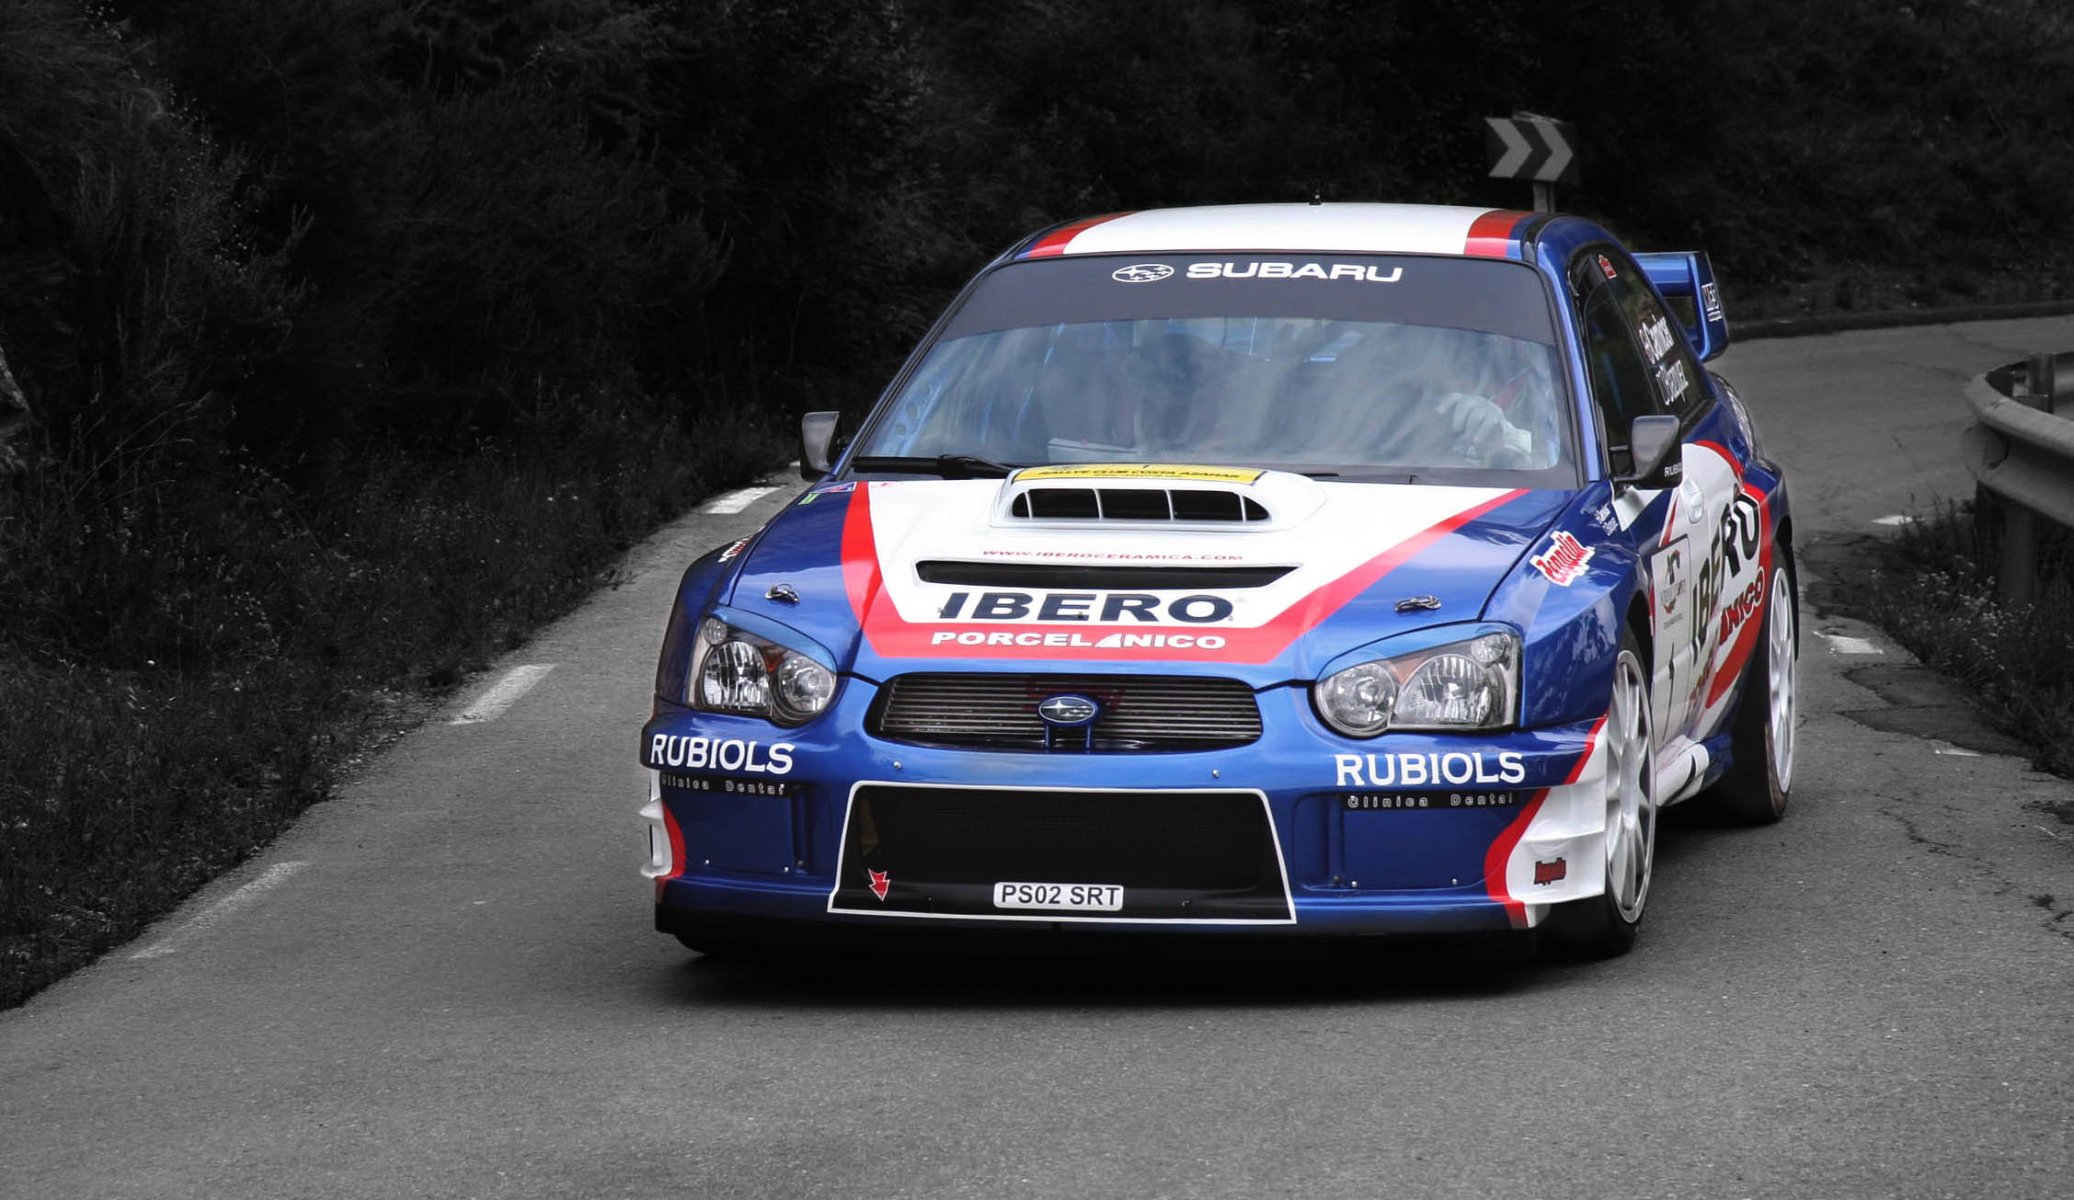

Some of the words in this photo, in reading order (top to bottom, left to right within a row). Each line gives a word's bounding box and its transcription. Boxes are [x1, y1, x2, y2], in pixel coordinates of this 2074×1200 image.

[1186, 262, 1403, 283] SUBARU
[1691, 490, 1761, 667] IBERO
[938, 592, 1235, 624] IBERO
[930, 631, 1227, 650] PORCELANICO
[650, 733, 796, 775] RUBIOLS
[1334, 752, 1526, 786] RUBIOLS
[1450, 792, 1513, 807] Dental
[1001, 884, 1061, 904] PS02
[1069, 886, 1121, 906] SRT
